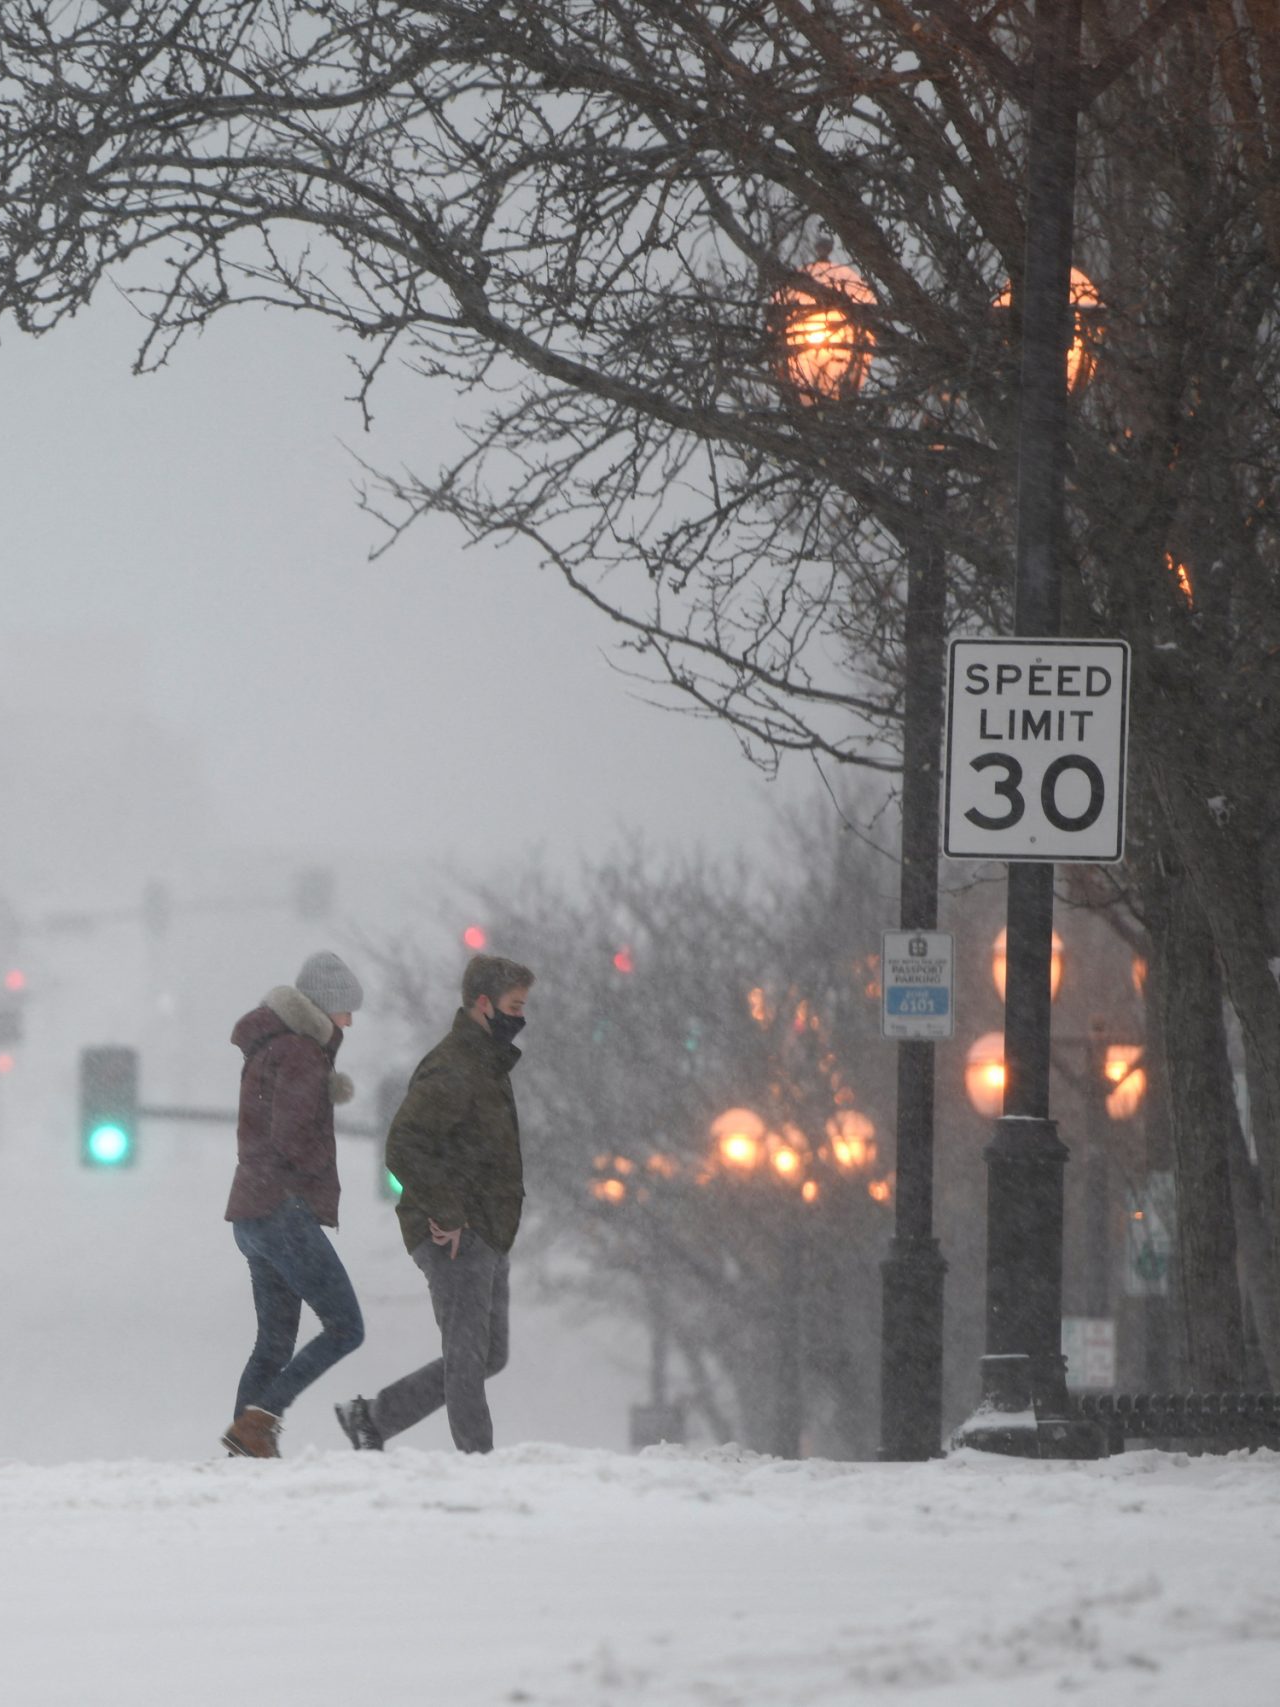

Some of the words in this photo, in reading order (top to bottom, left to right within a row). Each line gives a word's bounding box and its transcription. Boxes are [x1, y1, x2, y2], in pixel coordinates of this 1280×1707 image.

[964, 663, 1112, 697] SPEED
[979, 708, 1094, 742] LIMIT
[963, 752, 1105, 832] 30
[891, 965, 943, 974] PASSPORT
[895, 975, 941, 984] PARKING
[899, 999, 935, 1012] 6101
